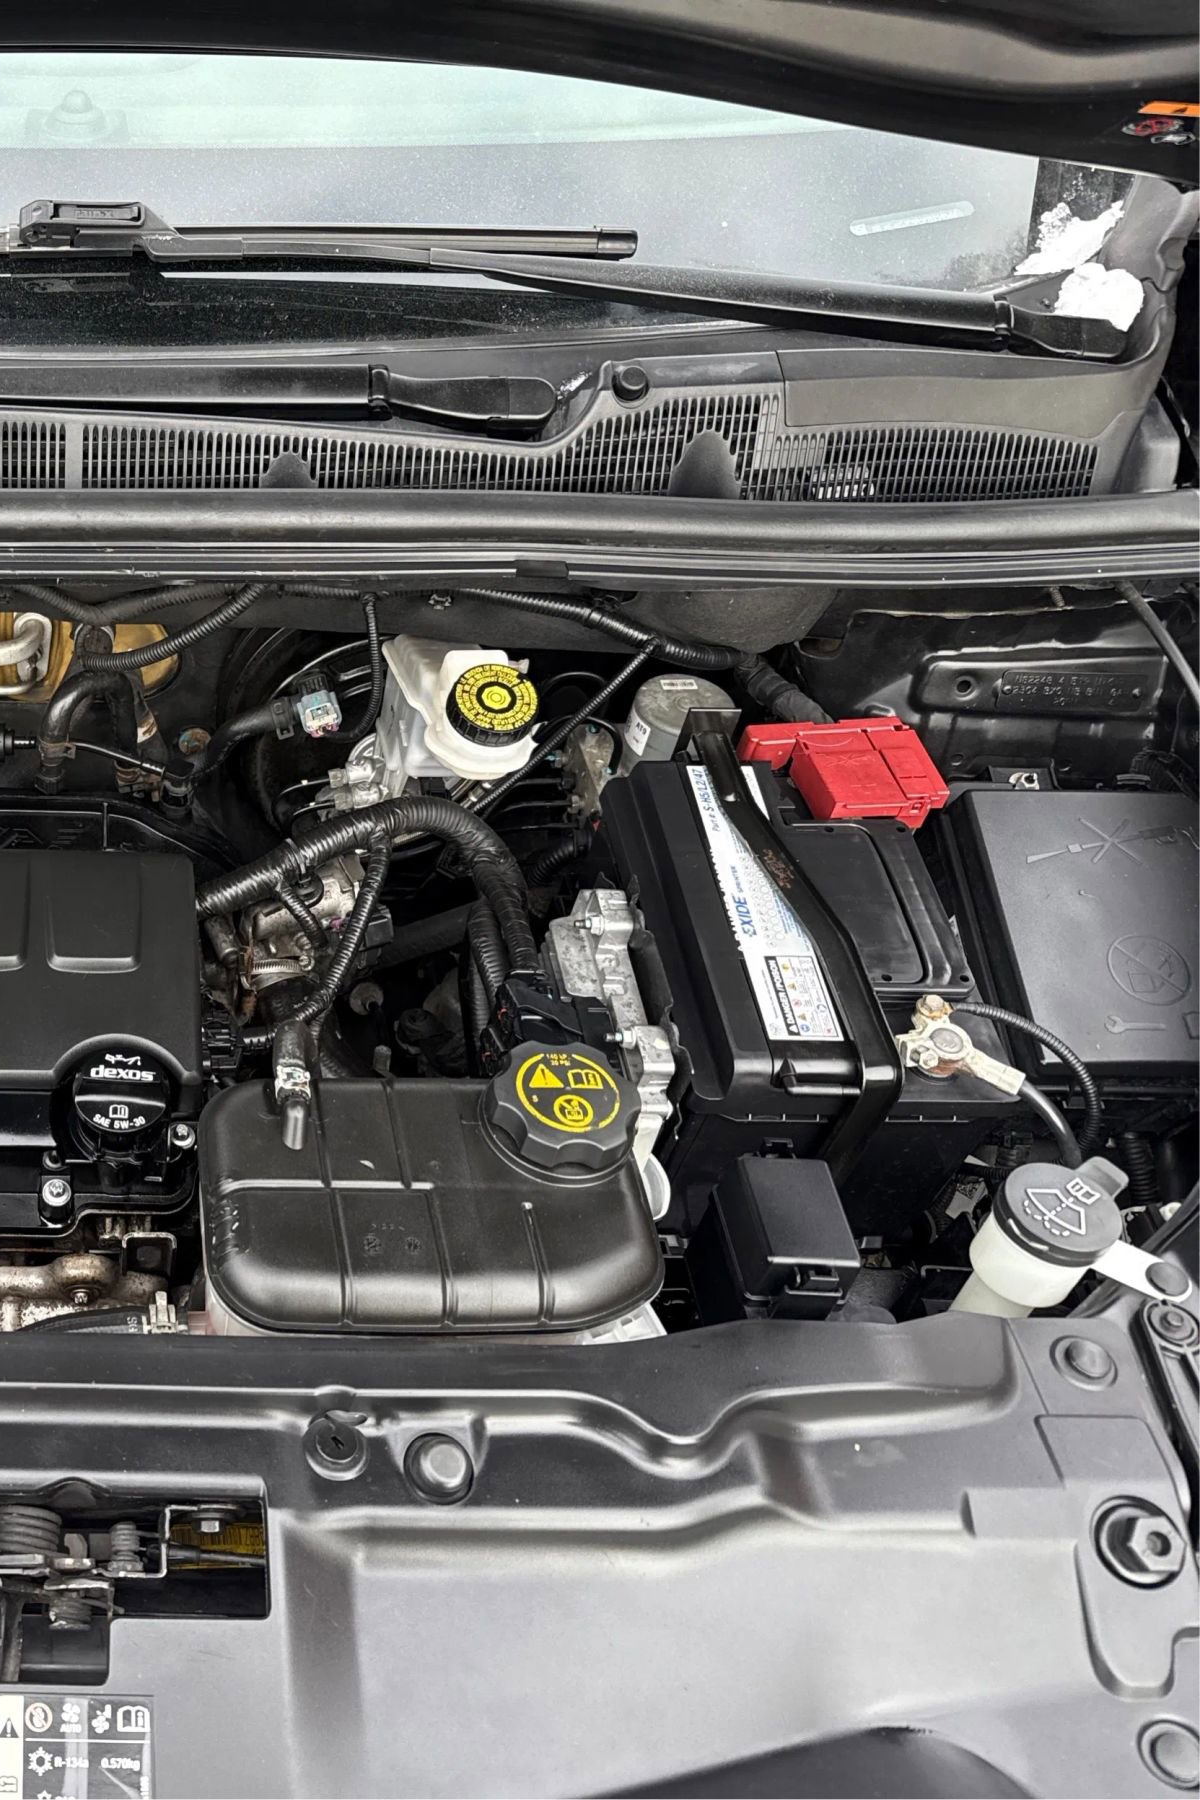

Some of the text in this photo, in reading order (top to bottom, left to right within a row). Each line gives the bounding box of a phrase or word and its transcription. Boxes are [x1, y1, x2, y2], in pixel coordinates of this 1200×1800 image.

[732, 893, 757, 937] EXIDE
[90, 1065, 155, 1081] dexos
[93, 1114, 146, 1129] SAE 5W-30
[60, 1724, 82, 1733] AUTO
